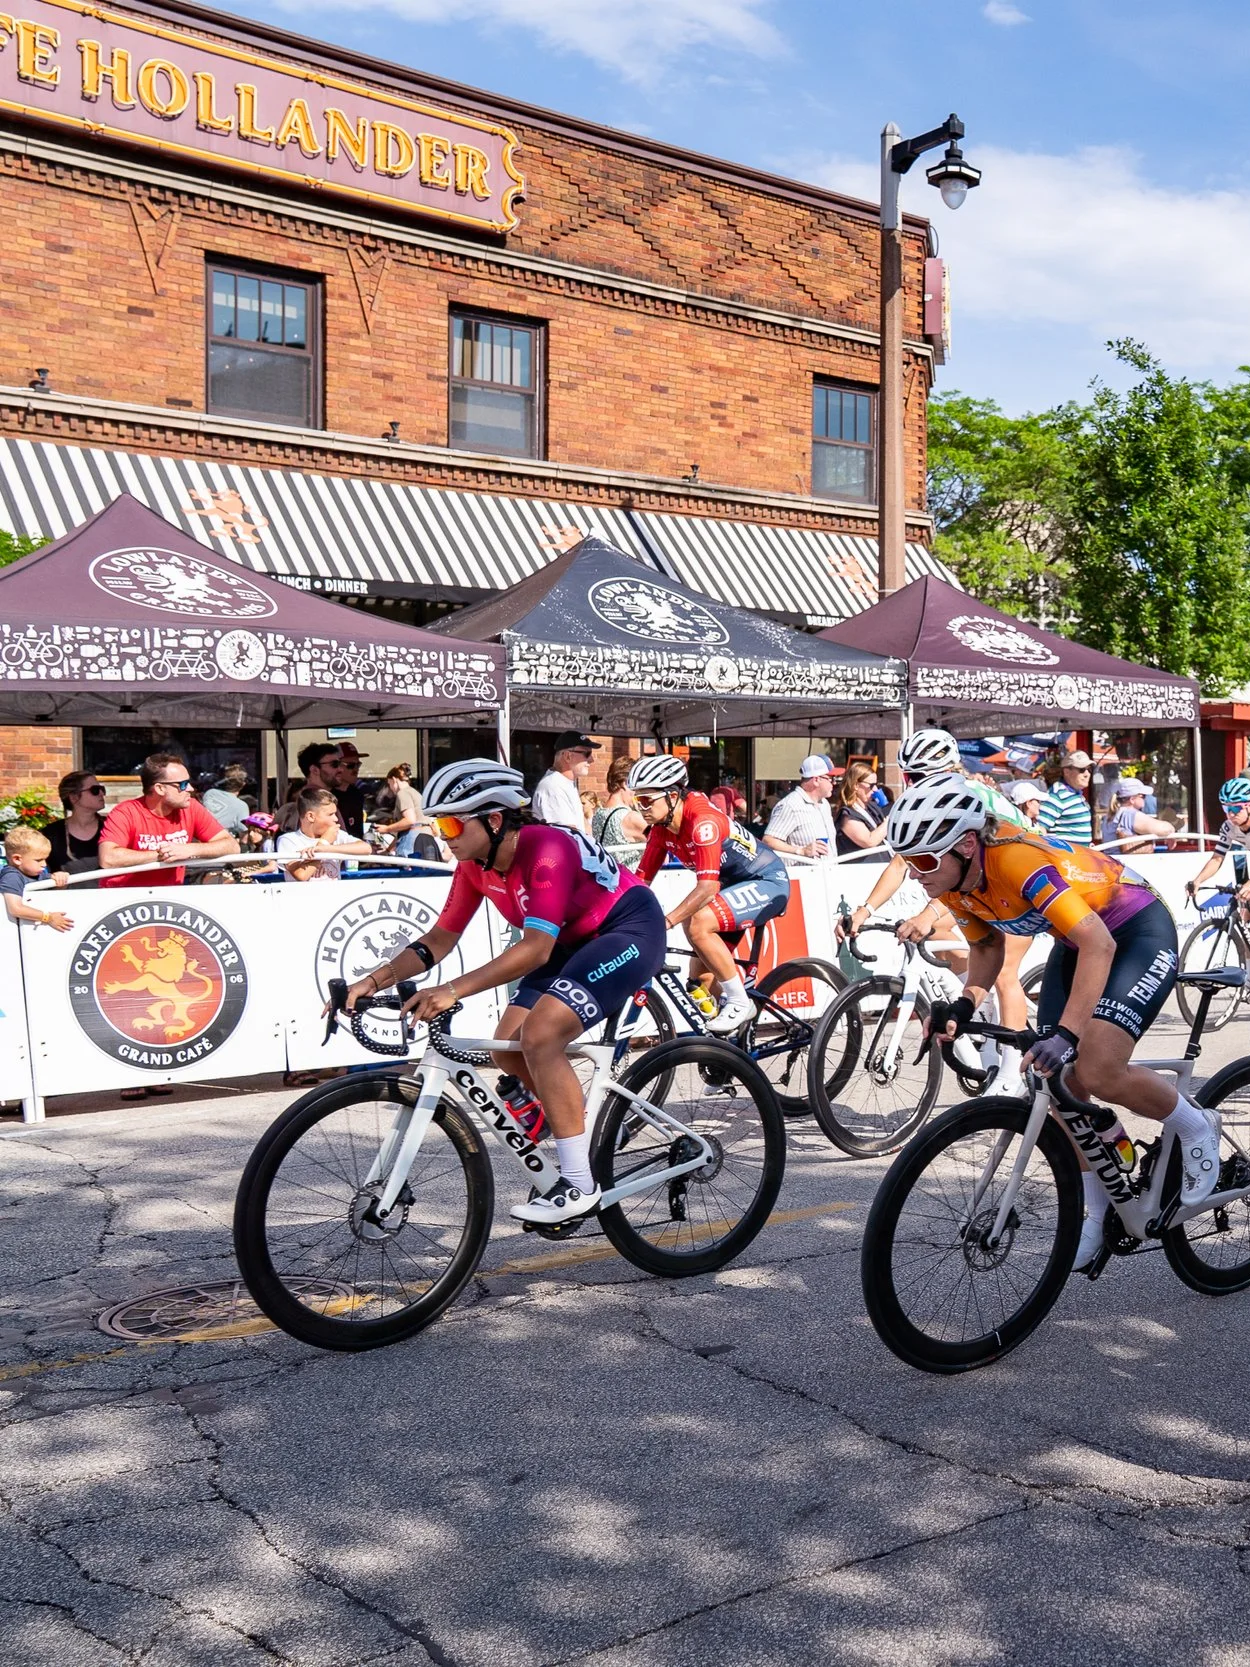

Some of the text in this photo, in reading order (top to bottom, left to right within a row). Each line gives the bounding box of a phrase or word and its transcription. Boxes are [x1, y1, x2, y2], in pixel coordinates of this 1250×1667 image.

[77, 38, 492, 200] HOLLANDER
[101, 551, 243, 587] LOWLANDS
[325, 579, 368, 594] DINNER
[596, 581, 695, 612] LOWLANDS
[129, 592, 213, 614] GRAND
[626, 623, 690, 641] GRAND
[449, 775, 475, 799] MET
[138, 833, 163, 842] TEAM
[724, 881, 770, 910] UTC
[75, 904, 239, 976] CAFE HOLLANDER
[587, 943, 641, 983] cutaway
[74, 986, 89, 995] 20
[229, 974, 244, 984] 06
[1127, 973, 1162, 1005] TEAM
[660, 973, 697, 1016] QUICK
[1094, 1006, 1141, 1038] CLE REPAIR
[117, 1037, 214, 1065] GRAND CAFÉ
